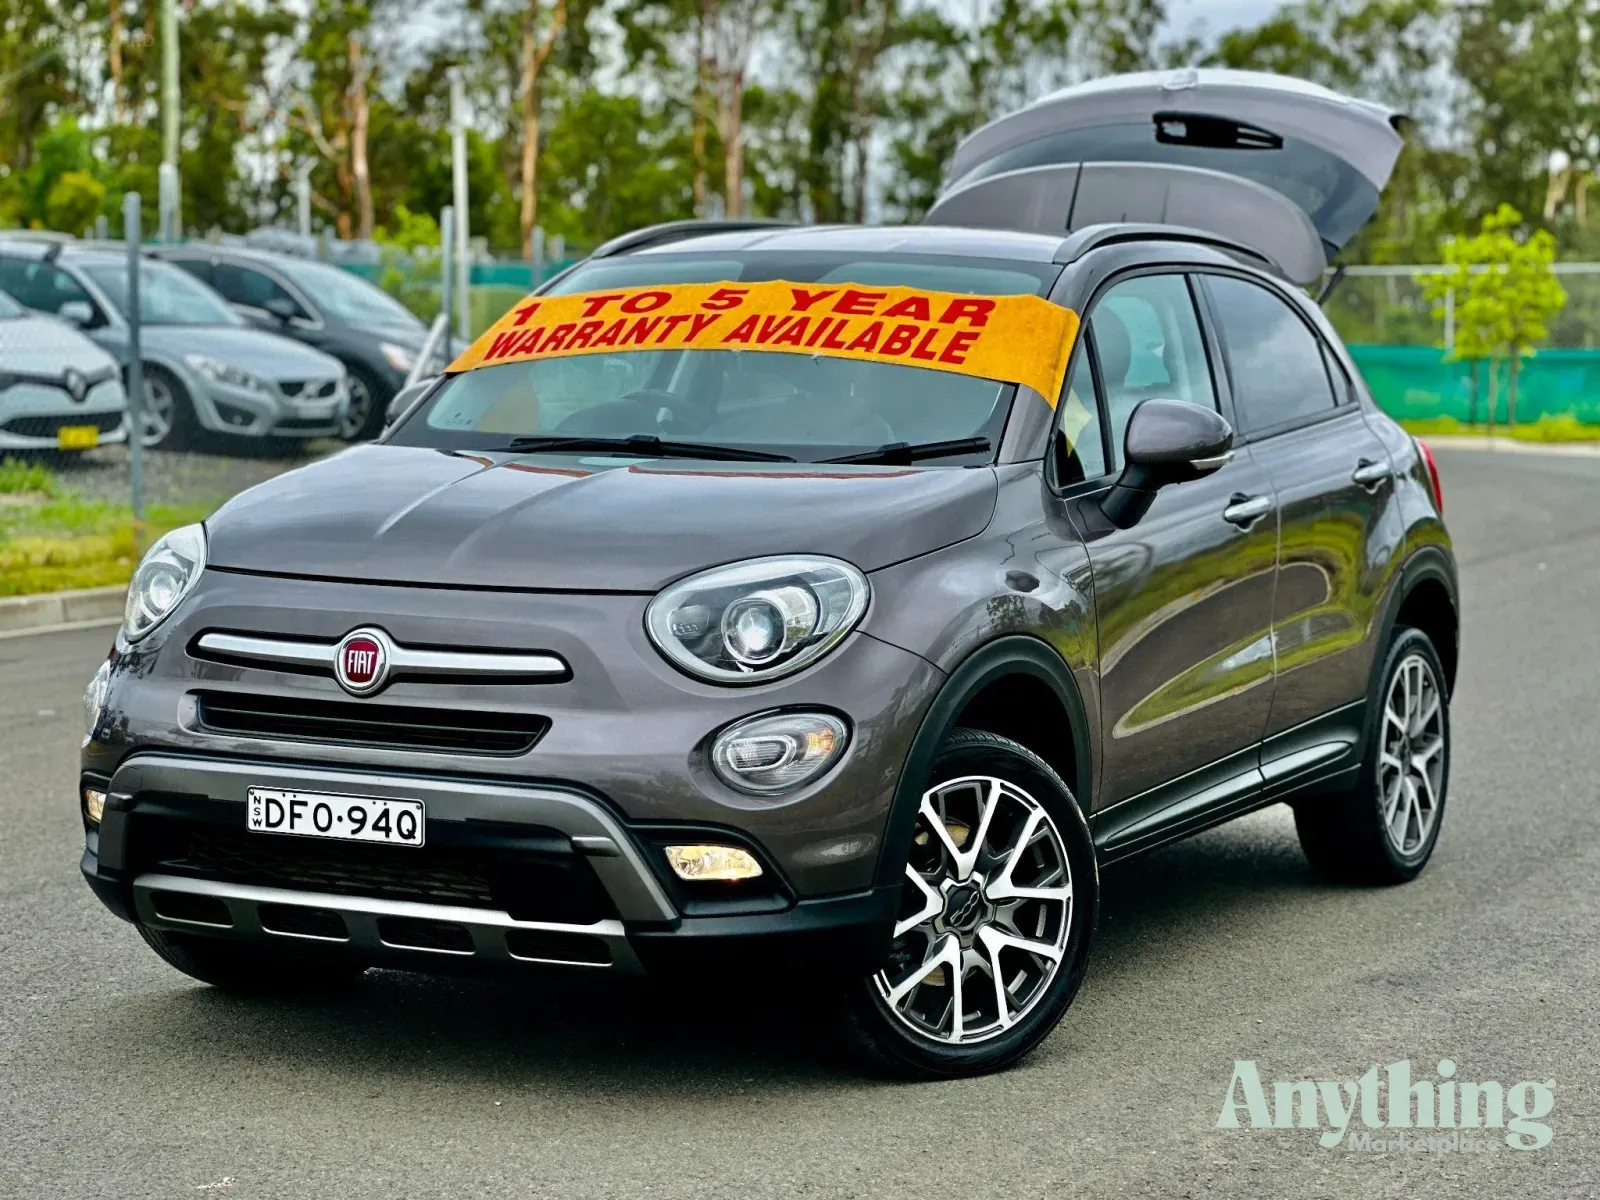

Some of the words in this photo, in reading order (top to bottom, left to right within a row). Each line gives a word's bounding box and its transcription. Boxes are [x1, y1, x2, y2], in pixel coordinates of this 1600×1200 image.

[514, 302, 542, 326] 1
[581, 291, 673, 318] TO
[701, 288, 750, 311] 5
[790, 288, 996, 327] YEAR
[484, 314, 722, 361] WARRANTY
[721, 313, 981, 365] AVAILABLE
[347, 649, 375, 675] FIAT
